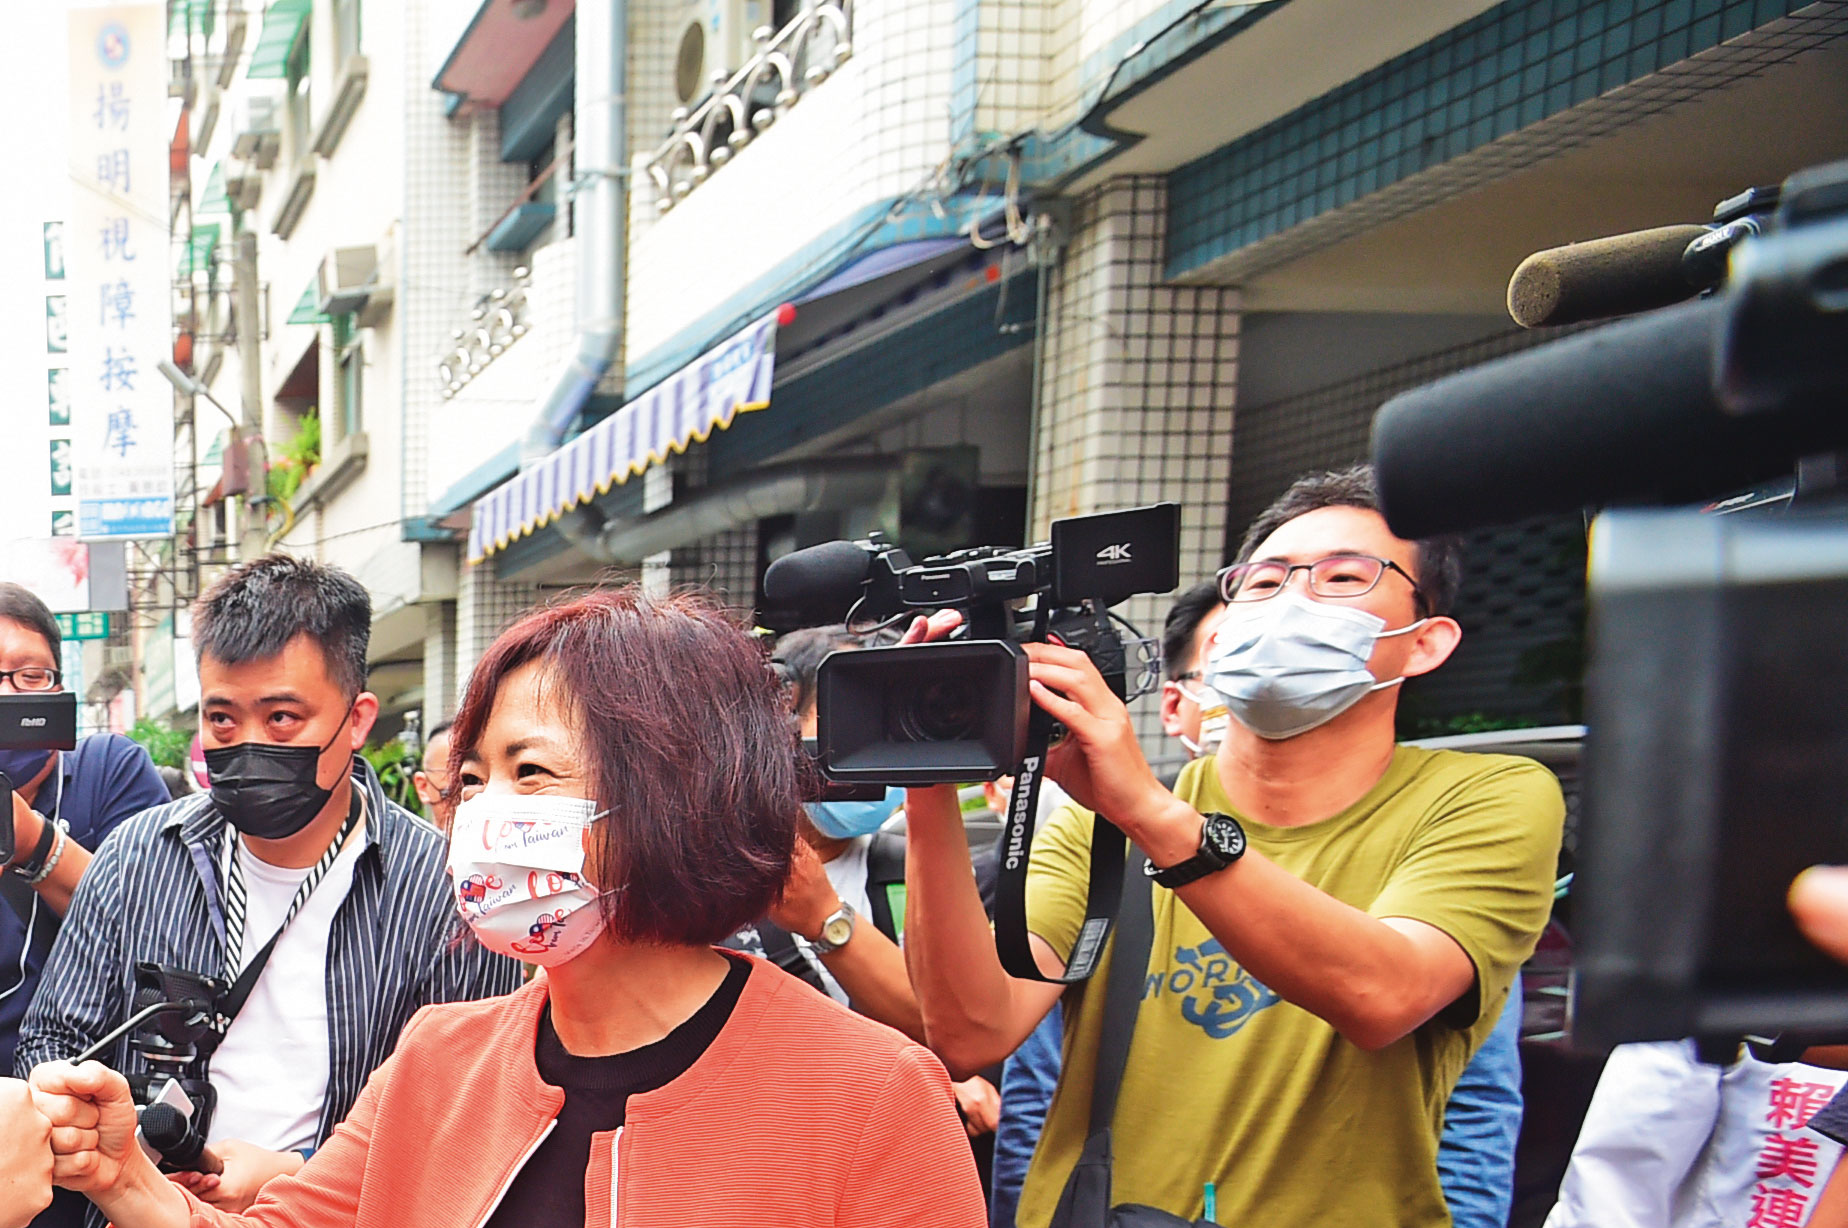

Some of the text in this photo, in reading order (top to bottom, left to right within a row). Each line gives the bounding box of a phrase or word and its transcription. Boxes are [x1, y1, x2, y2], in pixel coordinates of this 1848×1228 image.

[93, 81, 138, 457] 揚明視障按摩
[1096, 542, 1132, 560] 4K
[1005, 756, 1040, 870] Panasonic
